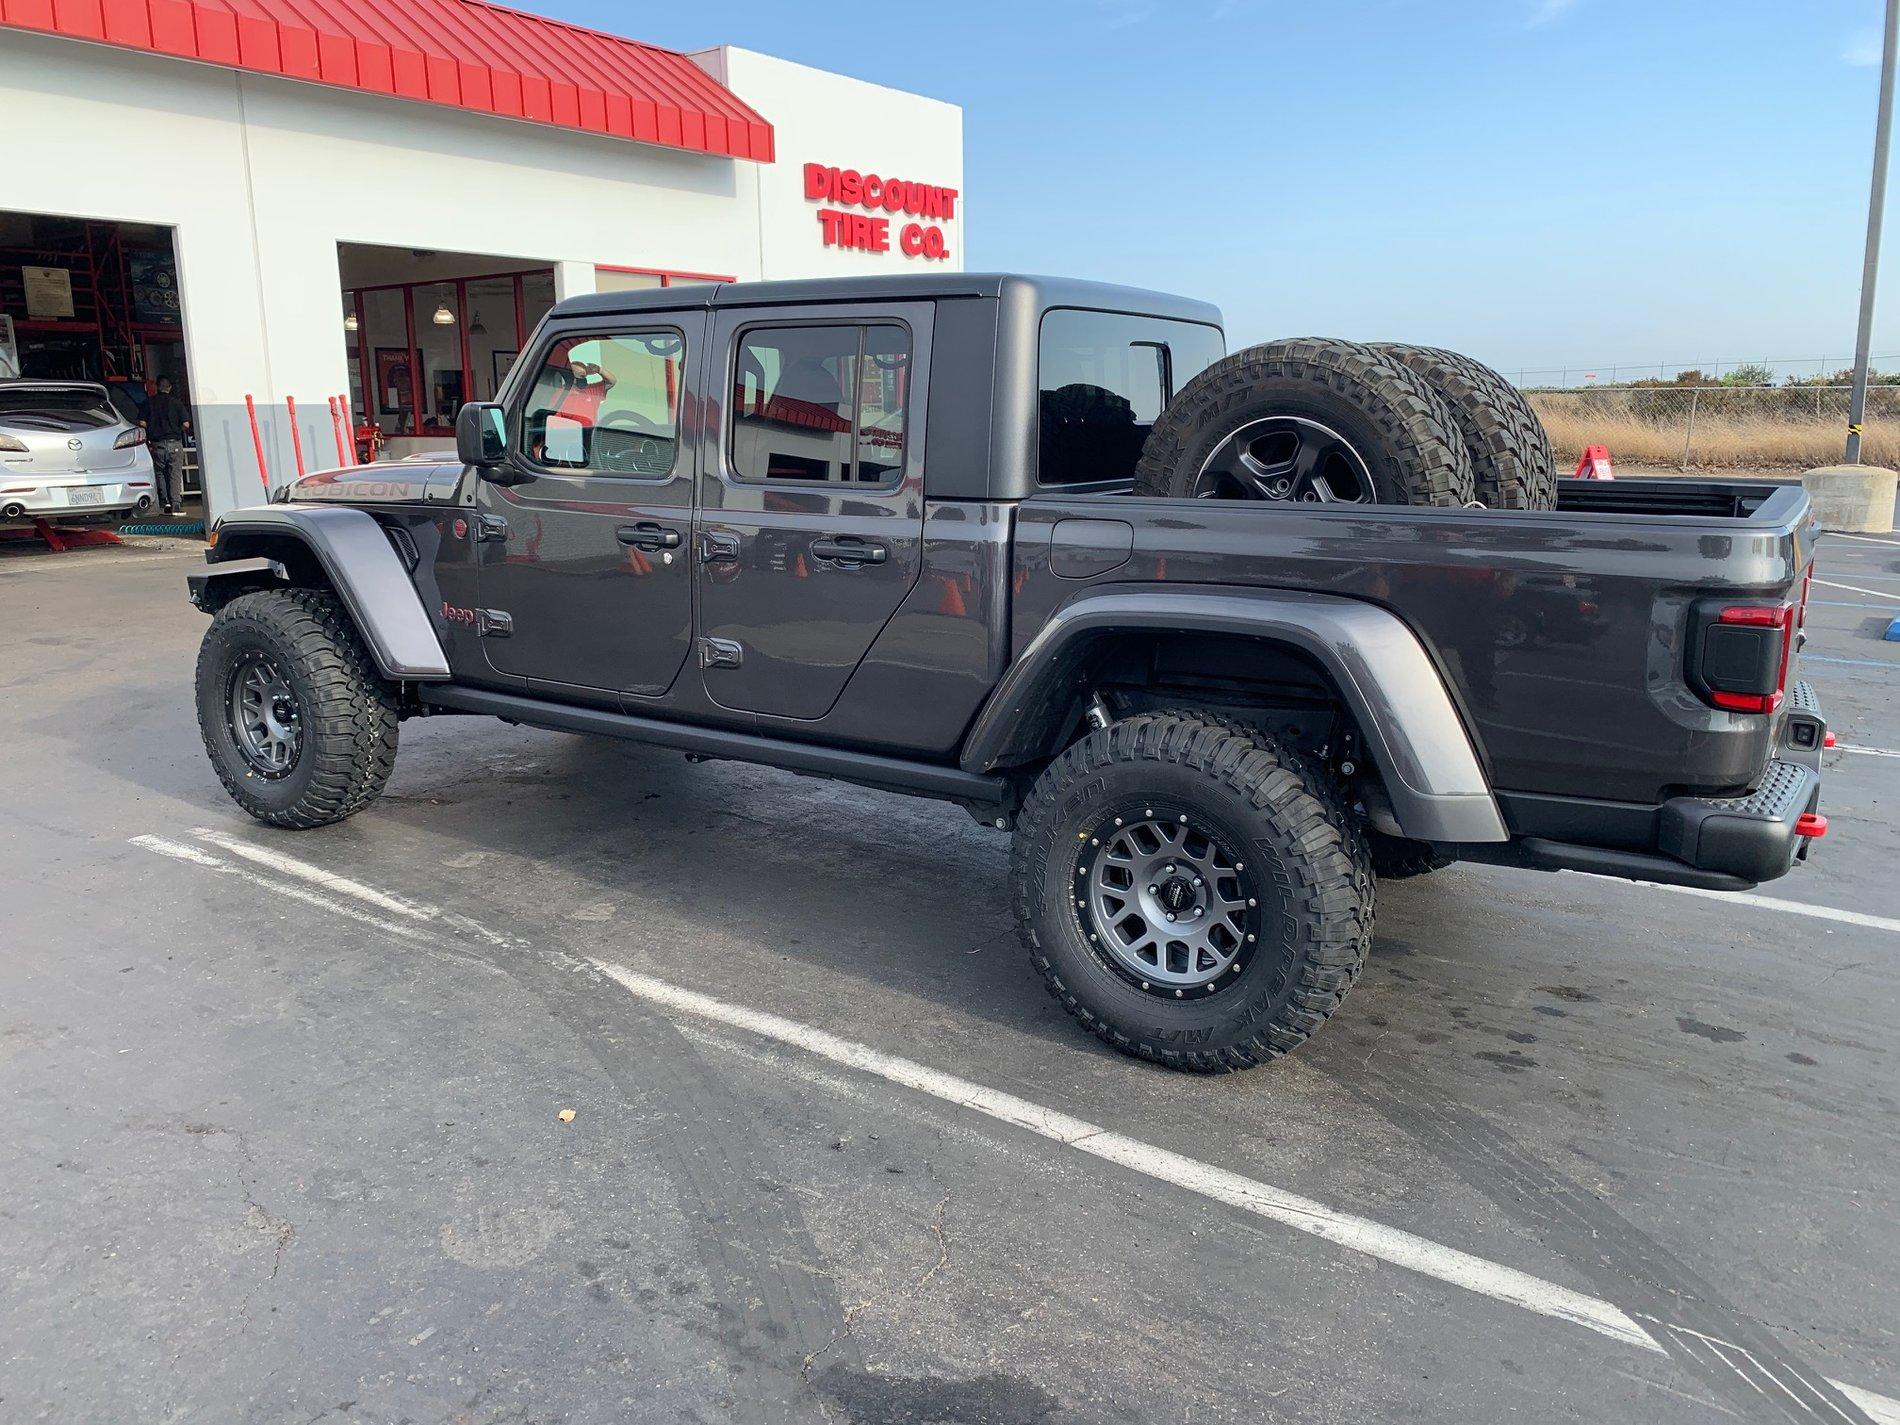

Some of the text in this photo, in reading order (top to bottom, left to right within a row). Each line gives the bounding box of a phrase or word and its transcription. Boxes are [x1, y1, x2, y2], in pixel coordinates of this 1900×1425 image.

[803, 163, 958, 220] DISCOUNT
[817, 208, 950, 260] TIRE CO.
[297, 483, 410, 497] RUBICON
[440, 601, 474, 626] Jeep
[1234, 837, 1299, 1028] WILDPEAK
